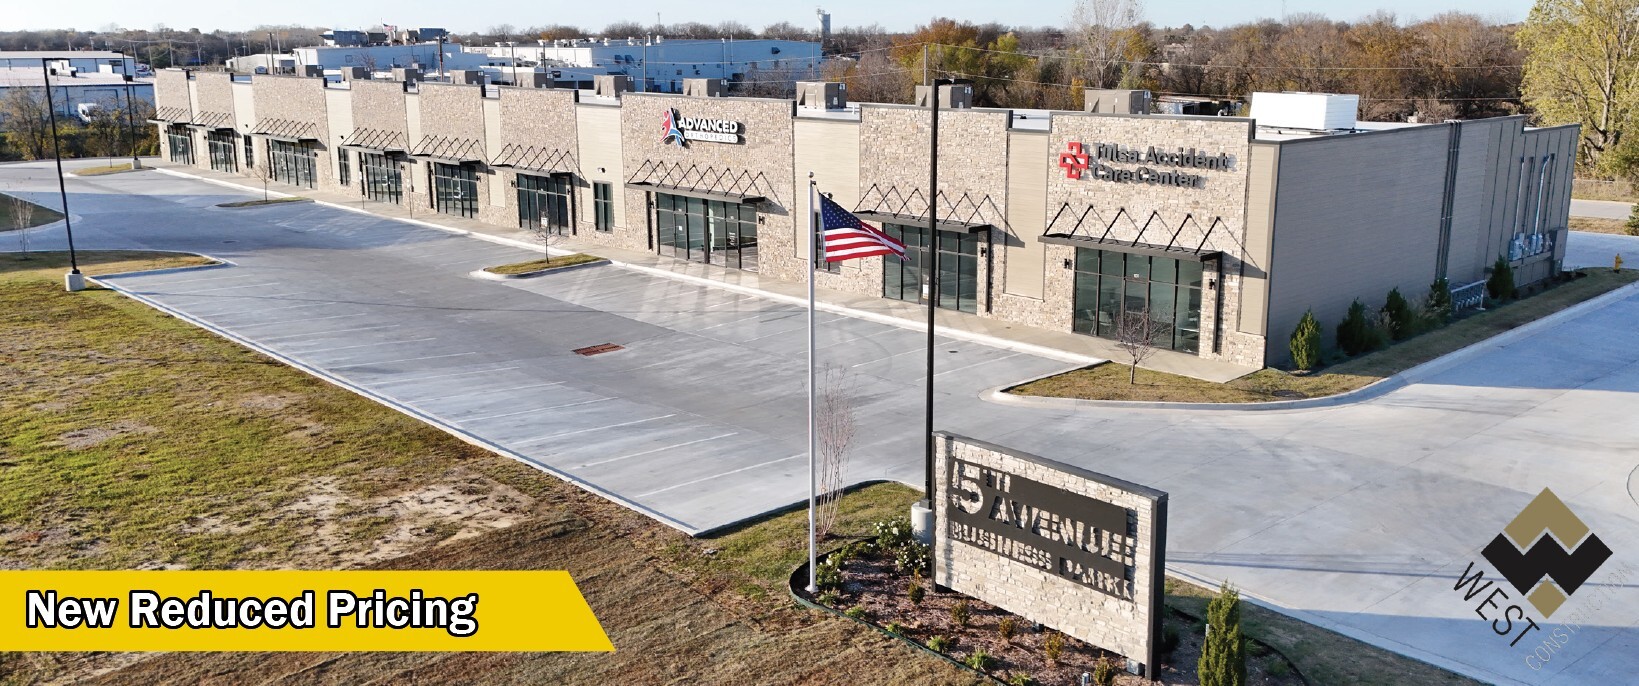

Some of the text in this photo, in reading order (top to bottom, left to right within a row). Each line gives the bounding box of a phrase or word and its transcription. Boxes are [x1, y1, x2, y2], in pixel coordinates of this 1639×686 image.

[678, 116, 738, 133] ADVANCED
[685, 131, 737, 141] ORTHOPEDICS
[1092, 143, 1228, 172] Tulsa Accident
[1091, 164, 1199, 189] Care Center
[988, 496, 1124, 564] AVENUE
[949, 520, 1053, 570] BUSINESS
[1059, 556, 1122, 597] PARK
